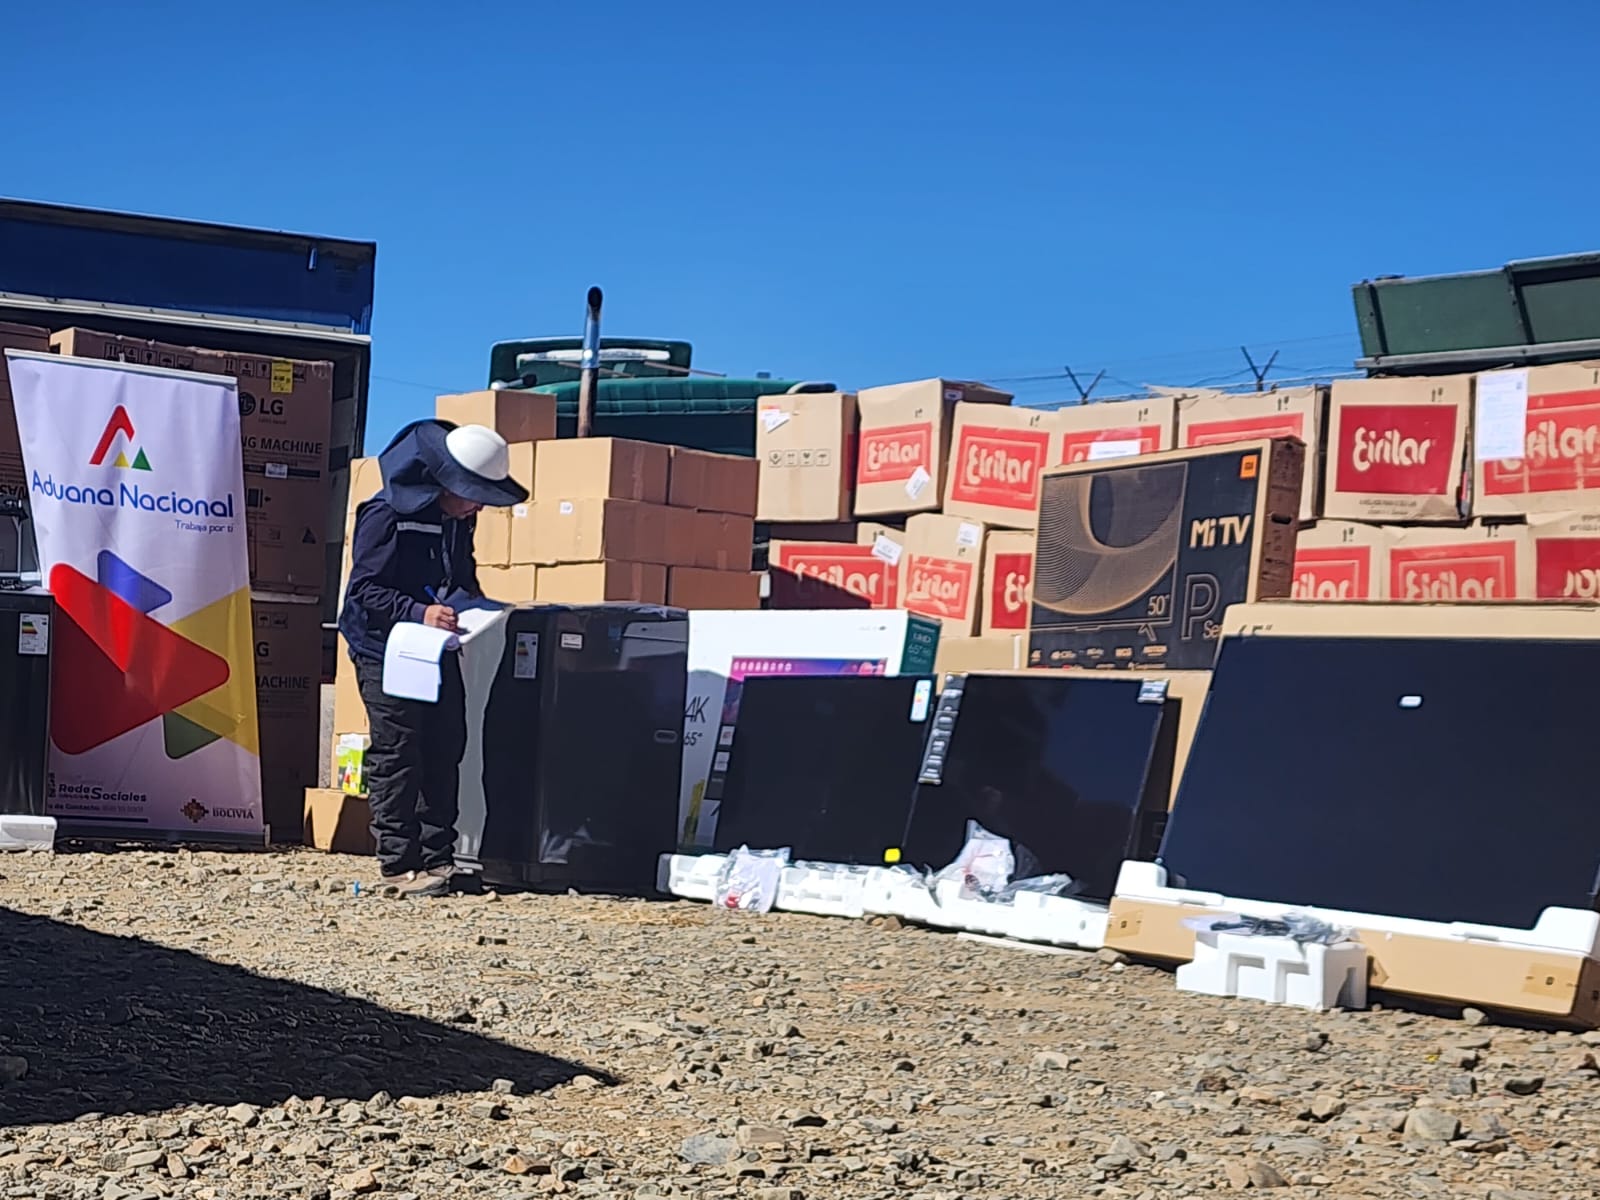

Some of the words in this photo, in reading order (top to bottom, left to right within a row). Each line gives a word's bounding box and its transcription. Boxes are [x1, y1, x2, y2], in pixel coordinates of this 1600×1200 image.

[260, 398, 284, 415] LG
[261, 437, 324, 455] MACHINE
[1353, 426, 1432, 472] Eirilar
[32, 469, 114, 506] Aduana
[119, 482, 234, 518] Nacional
[208, 525, 225, 535] por
[1189, 518, 1217, 549] Mi
[1218, 514, 1252, 546] TV
[1181, 573, 1220, 641] P
[212, 807, 255, 820] BOLIVIA
